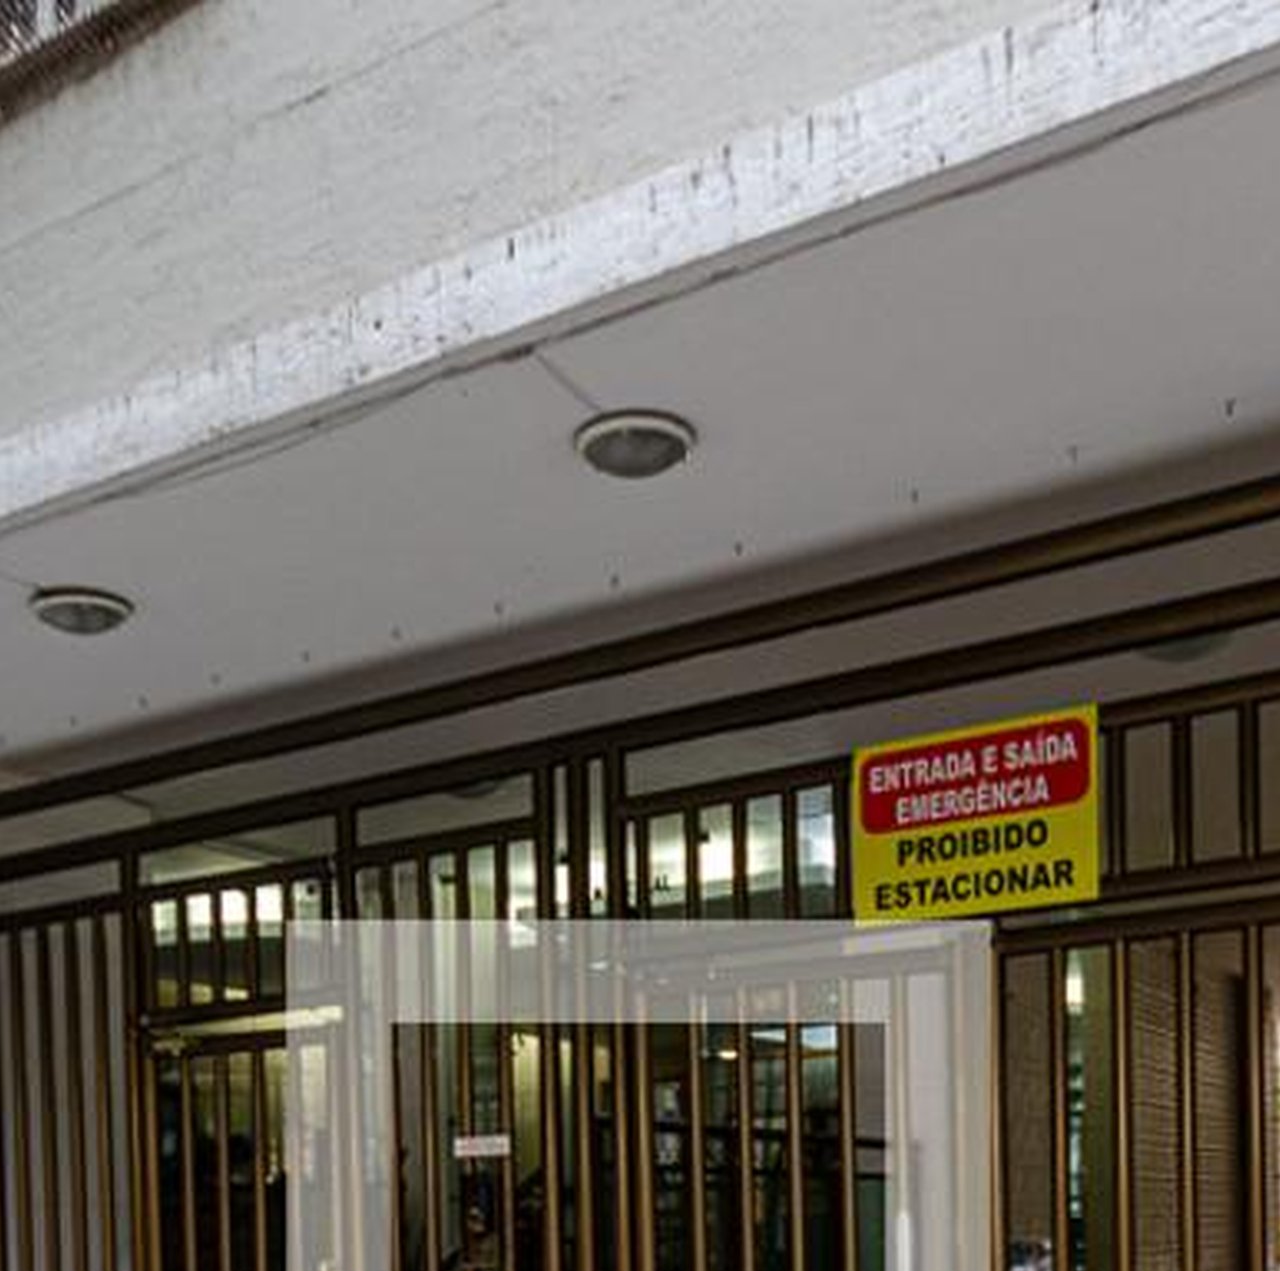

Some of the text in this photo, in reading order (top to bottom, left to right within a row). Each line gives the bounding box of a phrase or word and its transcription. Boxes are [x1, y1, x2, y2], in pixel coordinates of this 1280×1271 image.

[869, 730, 1078, 793] ENTRADA E SAÍDA
[895, 773, 1050, 825] EMERGÊNCIA
[897, 819, 1048, 868] PROIBIDO
[874, 859, 1074, 911] ESTACIONAR
